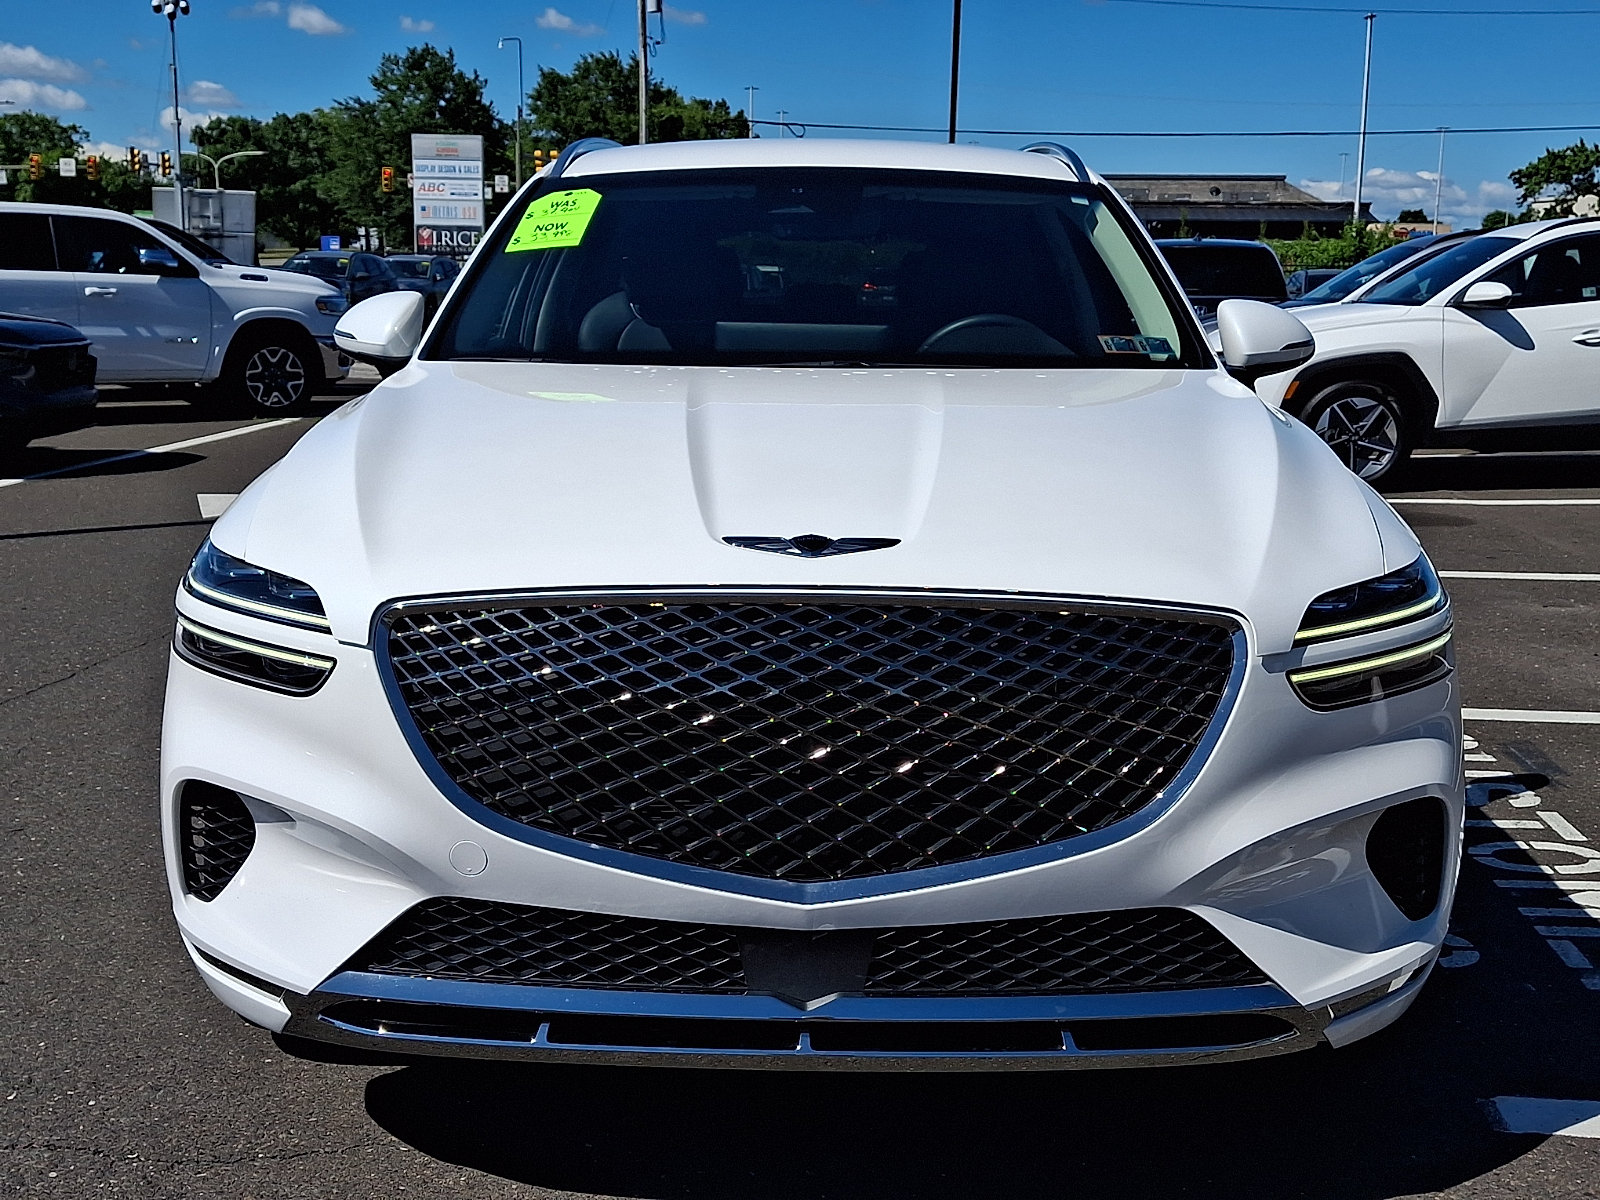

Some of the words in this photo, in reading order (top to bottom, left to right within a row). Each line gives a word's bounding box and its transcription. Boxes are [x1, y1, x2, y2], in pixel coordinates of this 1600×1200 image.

[438, 164, 456, 173] DESIGN
[464, 165, 480, 174] SALES
[418, 181, 446, 193] ABC
[550, 198, 578, 209] WAS
[533, 221, 569, 233] NOW
